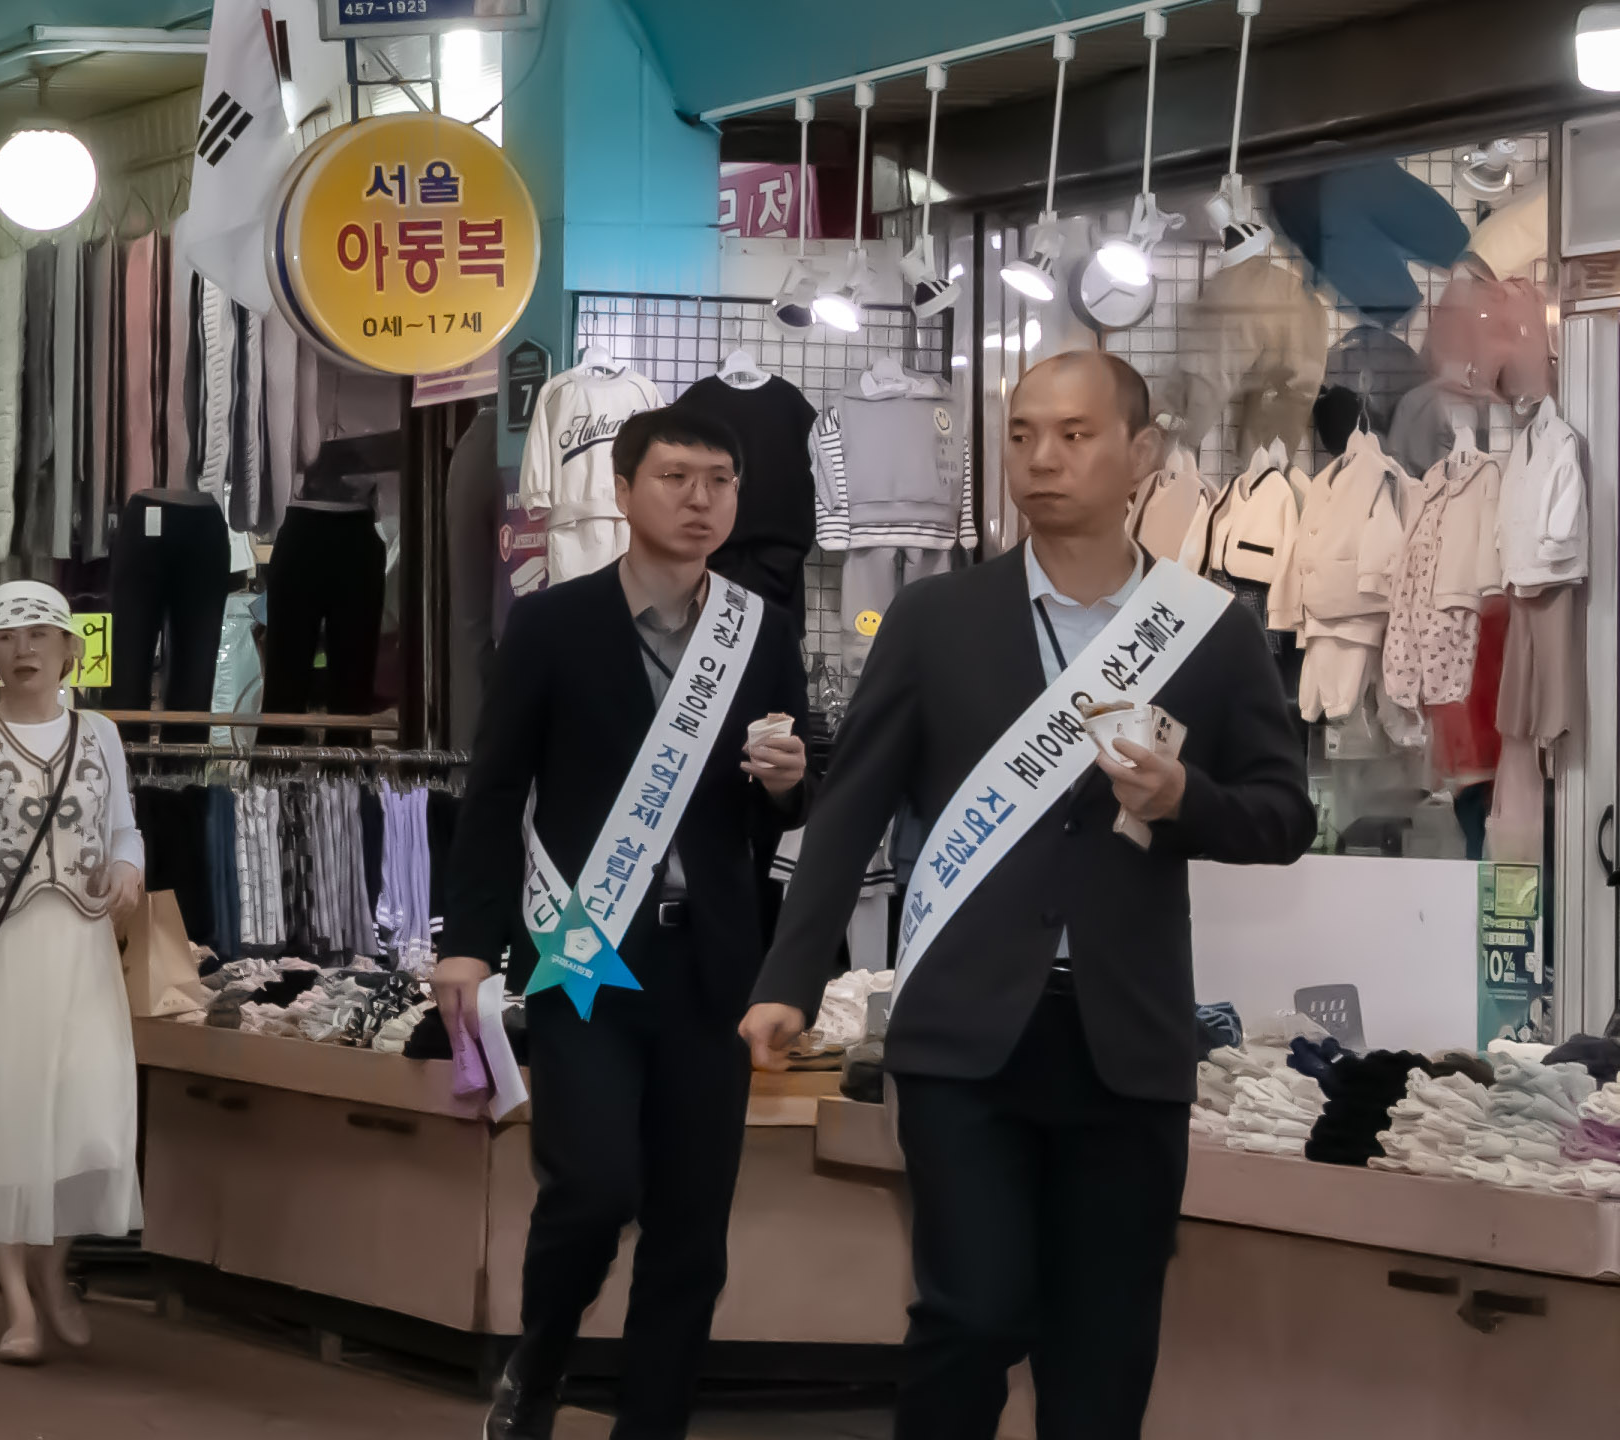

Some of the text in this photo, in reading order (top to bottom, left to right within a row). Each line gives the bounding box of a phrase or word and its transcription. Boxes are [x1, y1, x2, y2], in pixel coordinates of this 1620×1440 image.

[365, 161, 460, 205] 서울
[336, 216, 506, 295] 아동복
[1101, 601, 1185, 692] 전통시장
[629, 743, 689, 830] 지역경제
[585, 836, 648, 922] 살립시다
[930, 786, 1017, 889] 지역경제
